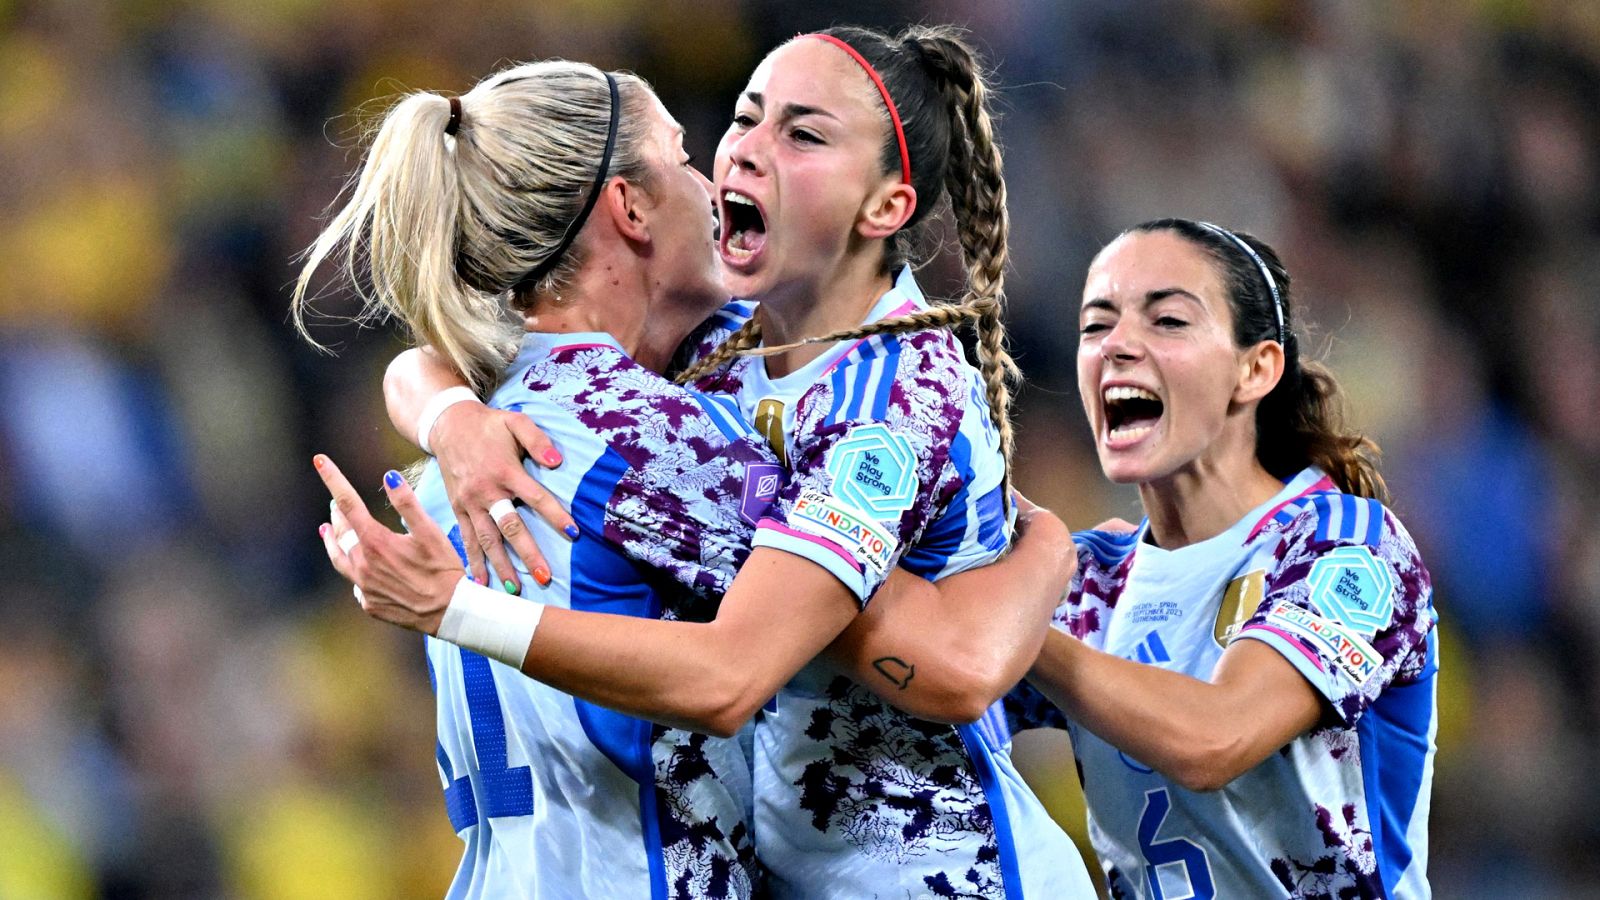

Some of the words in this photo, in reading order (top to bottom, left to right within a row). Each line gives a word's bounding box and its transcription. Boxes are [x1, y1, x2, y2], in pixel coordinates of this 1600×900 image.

[864, 451, 880, 465] We
[859, 461, 884, 480] Play
[856, 471, 892, 496] Strong
[802, 491, 826, 505] UEFA
[795, 500, 891, 562] FOUNDATION
[856, 545, 868, 555] for
[1345, 567, 1360, 581] We
[1339, 576, 1362, 595] Play
[1335, 584, 1369, 611] Strong
[1165, 609, 1183, 617] 2023
[1281, 602, 1306, 615] UEFA
[1274, 607, 1374, 676] FOUNDATION
[1137, 786, 1217, 900] 6
